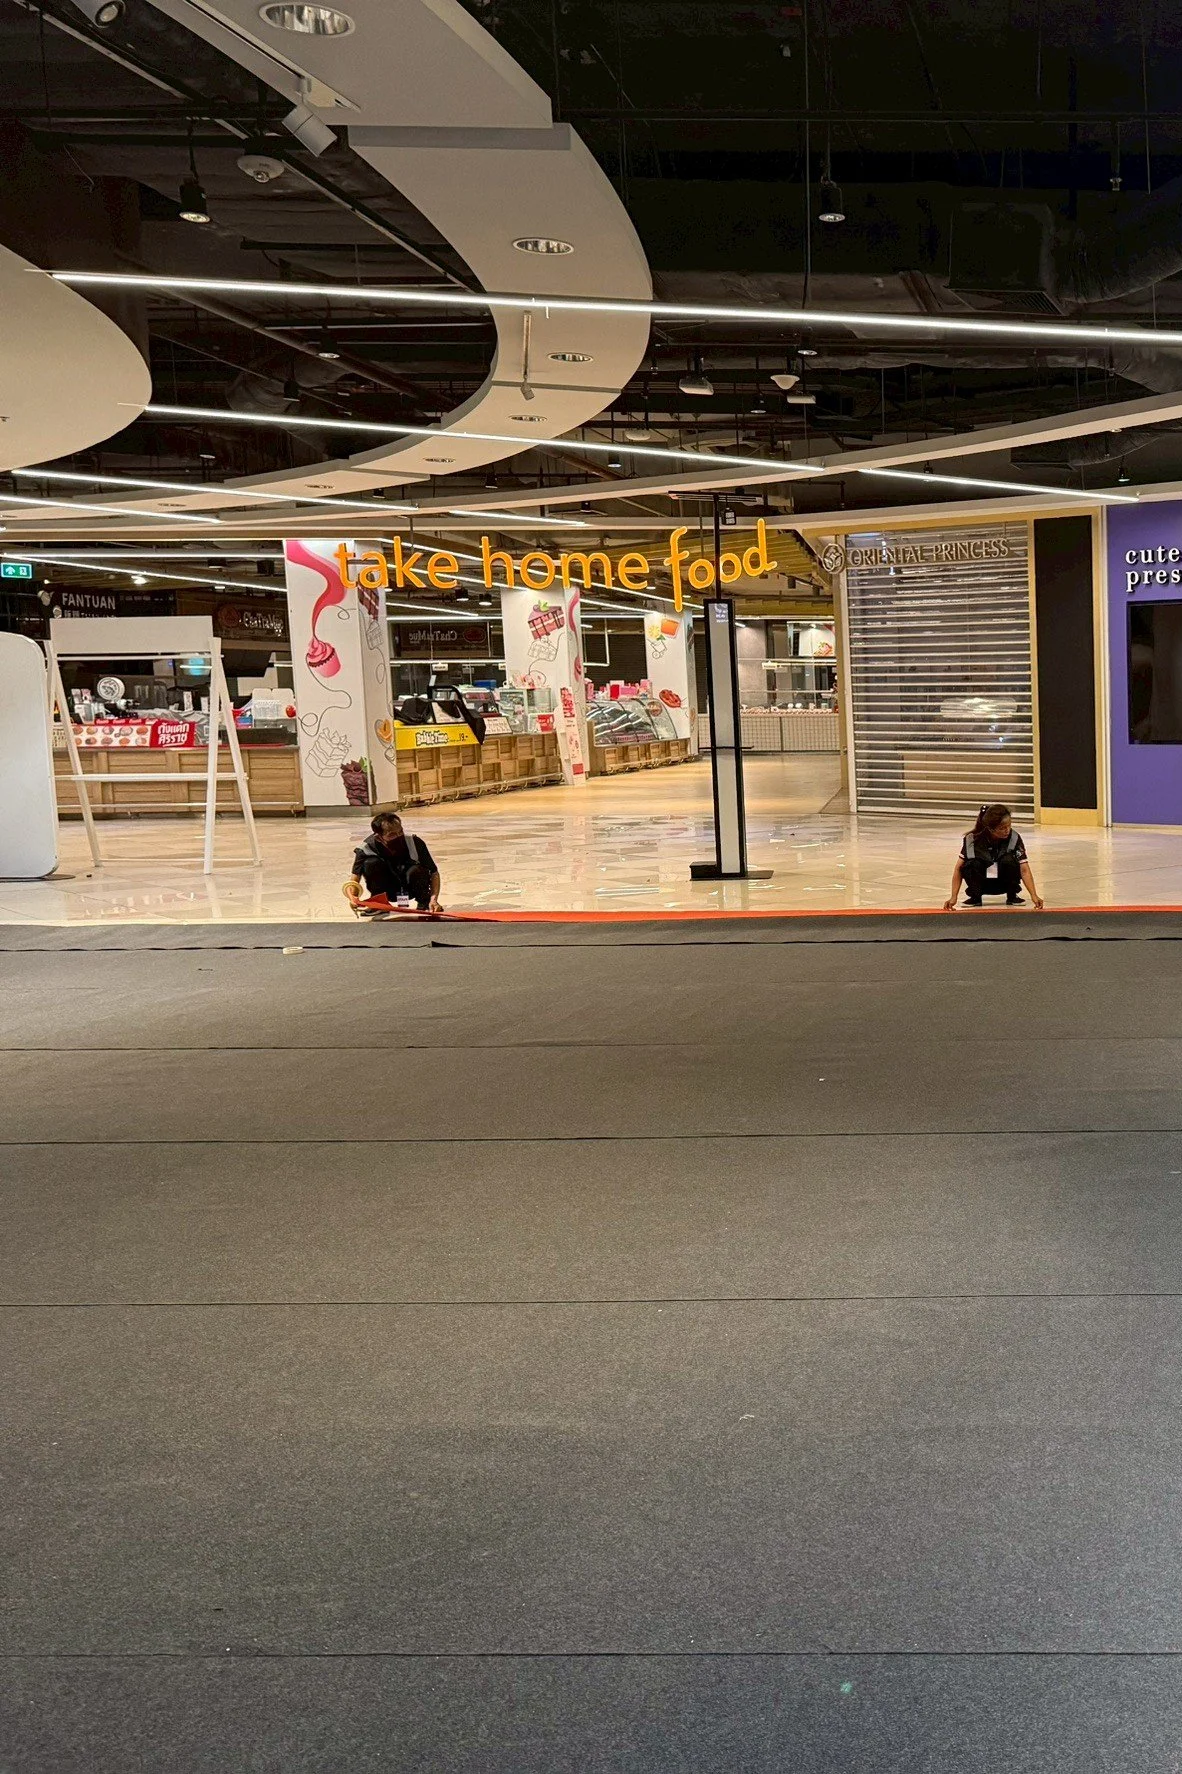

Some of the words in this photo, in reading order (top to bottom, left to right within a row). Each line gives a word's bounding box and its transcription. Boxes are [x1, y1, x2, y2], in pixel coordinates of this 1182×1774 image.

[850, 546, 926, 567] ORIENTAL
[932, 538, 1010, 562] PRINCESS
[1125, 545, 1182, 565] cute
[333, 535, 459, 590] take
[480, 535, 650, 590] home
[664, 518, 778, 613] food
[62, 592, 117, 610] FANTUAN
